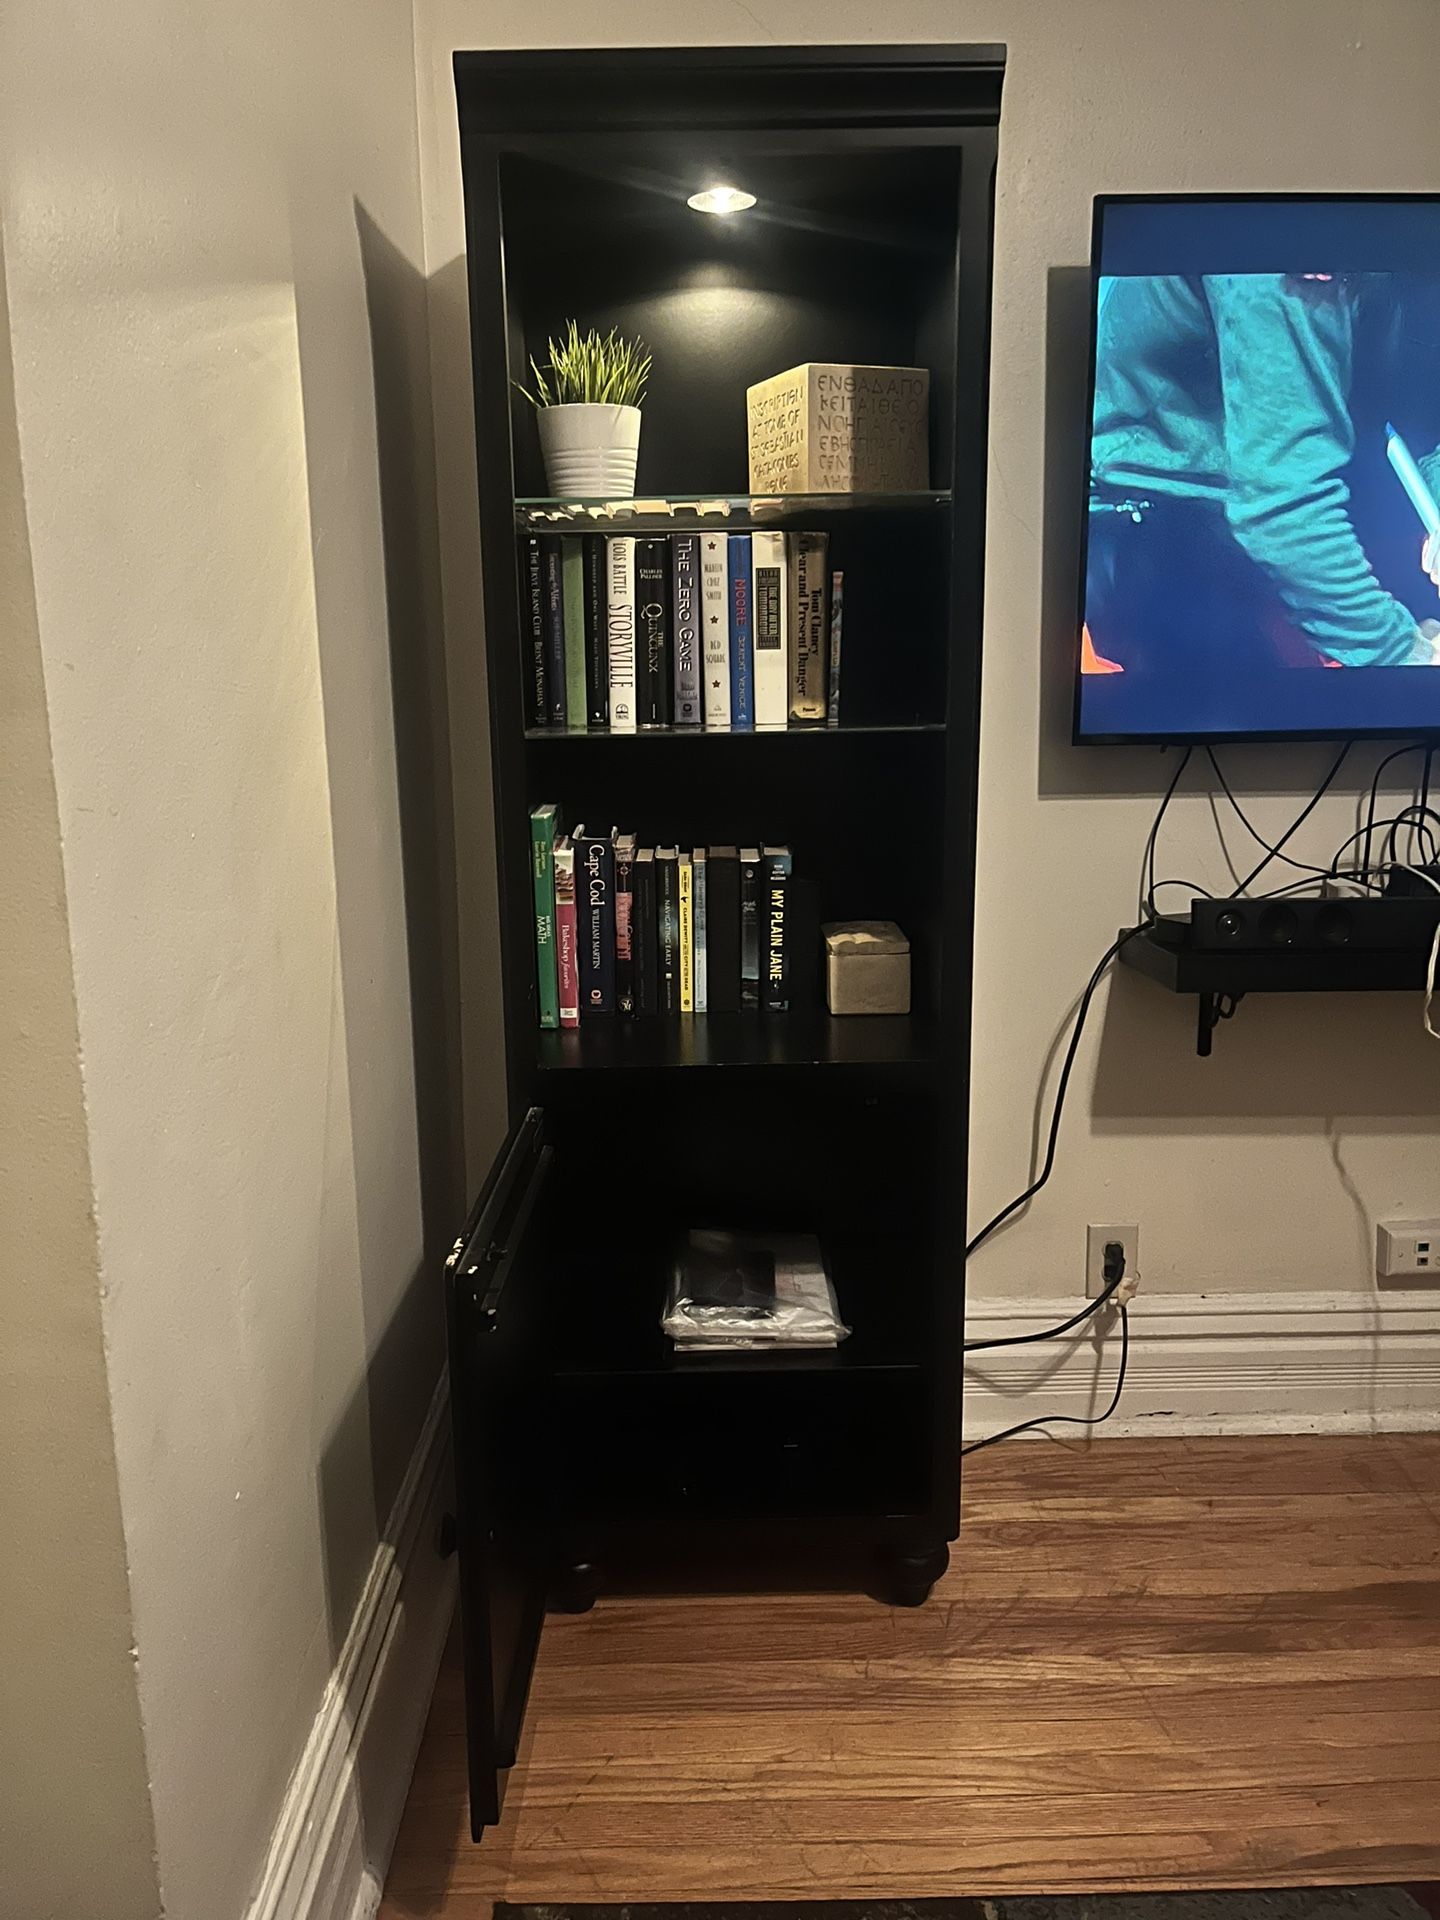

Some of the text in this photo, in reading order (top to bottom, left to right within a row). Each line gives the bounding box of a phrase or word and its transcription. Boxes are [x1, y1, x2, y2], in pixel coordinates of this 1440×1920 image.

[788, 409, 800, 426] OF
[613, 543, 627, 595] LOIS BATTLE
[678, 539, 692, 572] THE
[531, 589, 541, 614] ISLAND
[678, 577, 693, 622] ZERO
[734, 578, 747, 627] MOORE
[798, 574, 809, 598] and
[532, 615, 542, 636] CLUB
[641, 603, 663, 673] QUINCUNX
[797, 602, 810, 649] Present
[808, 587, 822, 656] Tom Clancy
[608, 604, 633, 688] STORYVILLE
[679, 627, 694, 672] GAME
[796, 652, 810, 697] Danger
[584, 844, 605, 906] Cape Cod
[771, 889, 784, 908] MY
[537, 915, 547, 944] MATH
[561, 924, 570, 962] Bakeshop
[592, 908, 600, 970] WILLIAM MARTIN
[770, 911, 784, 946] PLAIN
[769, 949, 783, 981] JANE
